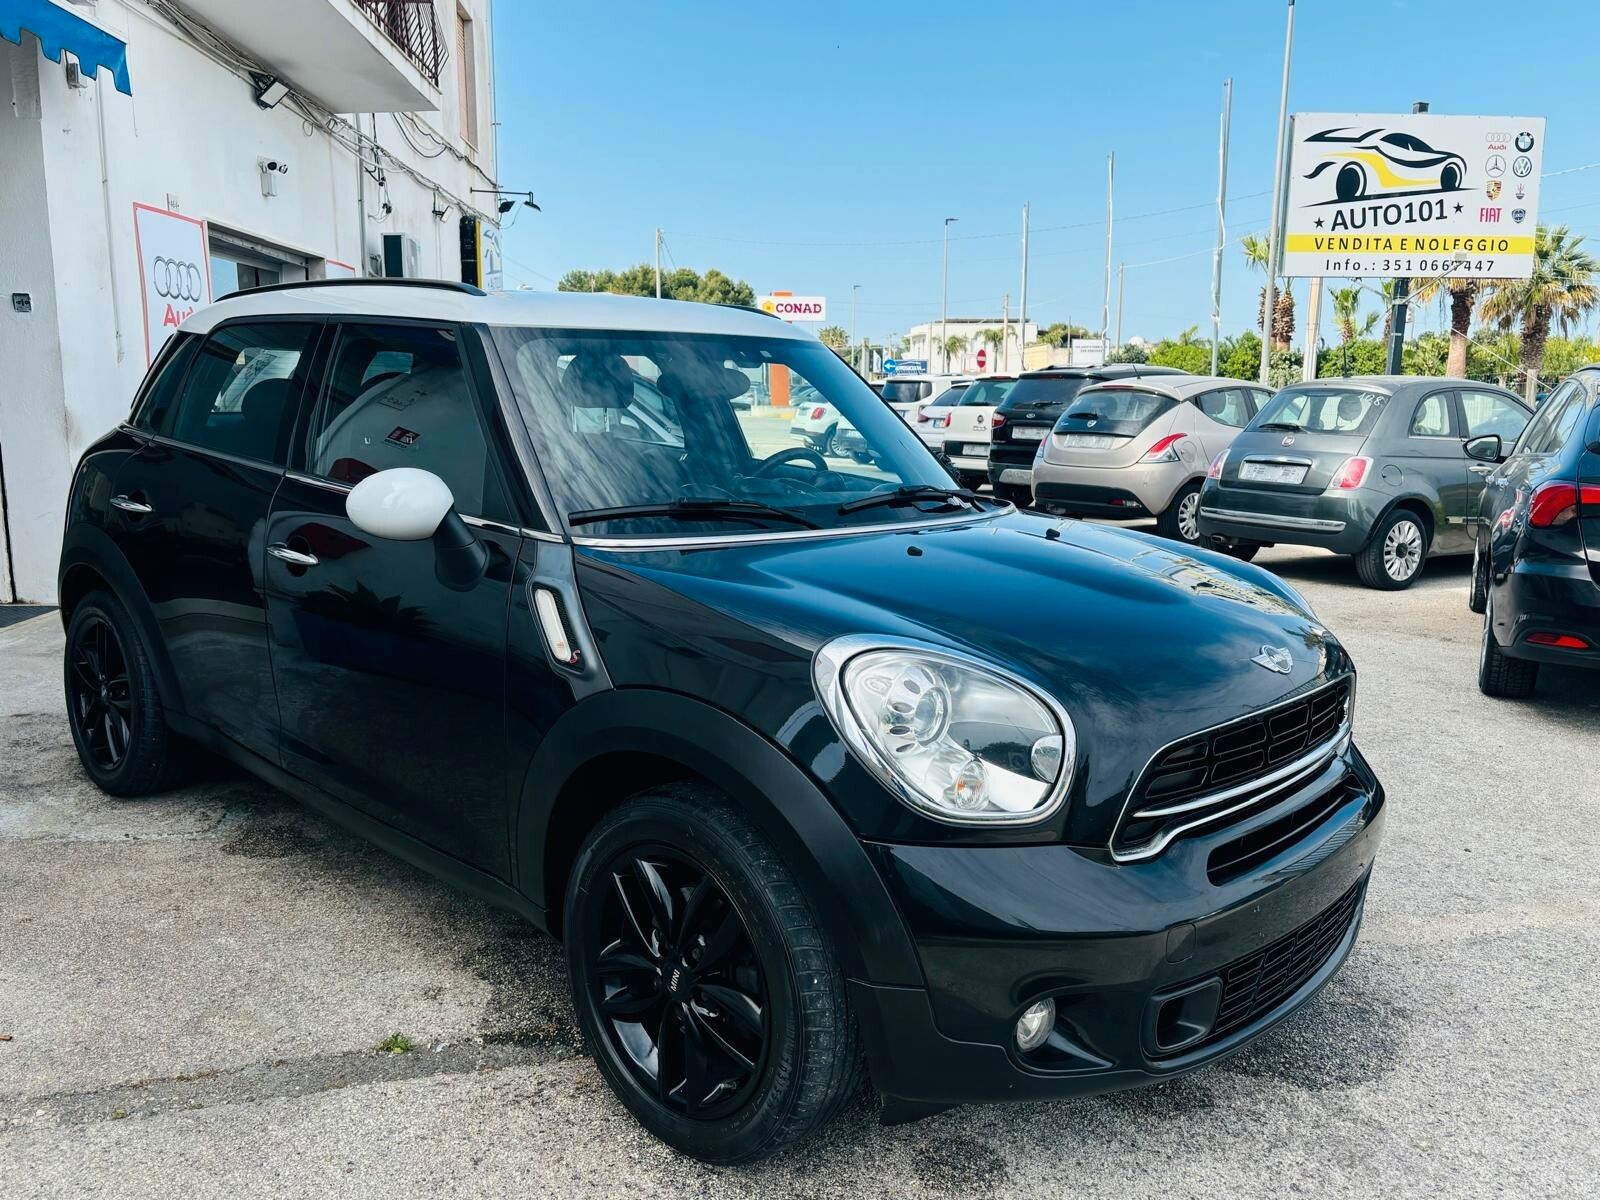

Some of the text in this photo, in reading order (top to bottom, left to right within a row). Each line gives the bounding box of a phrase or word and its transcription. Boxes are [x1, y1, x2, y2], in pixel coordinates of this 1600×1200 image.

[1487, 143, 1507, 151] Audi
[1330, 198, 1449, 232] AUTO101
[1479, 207, 1503, 223] FIAT
[1314, 237, 1509, 252] VENDITA E NOLEGGIO
[1382, 259, 1413, 272] 351
[775, 303, 822, 314] CONAD
